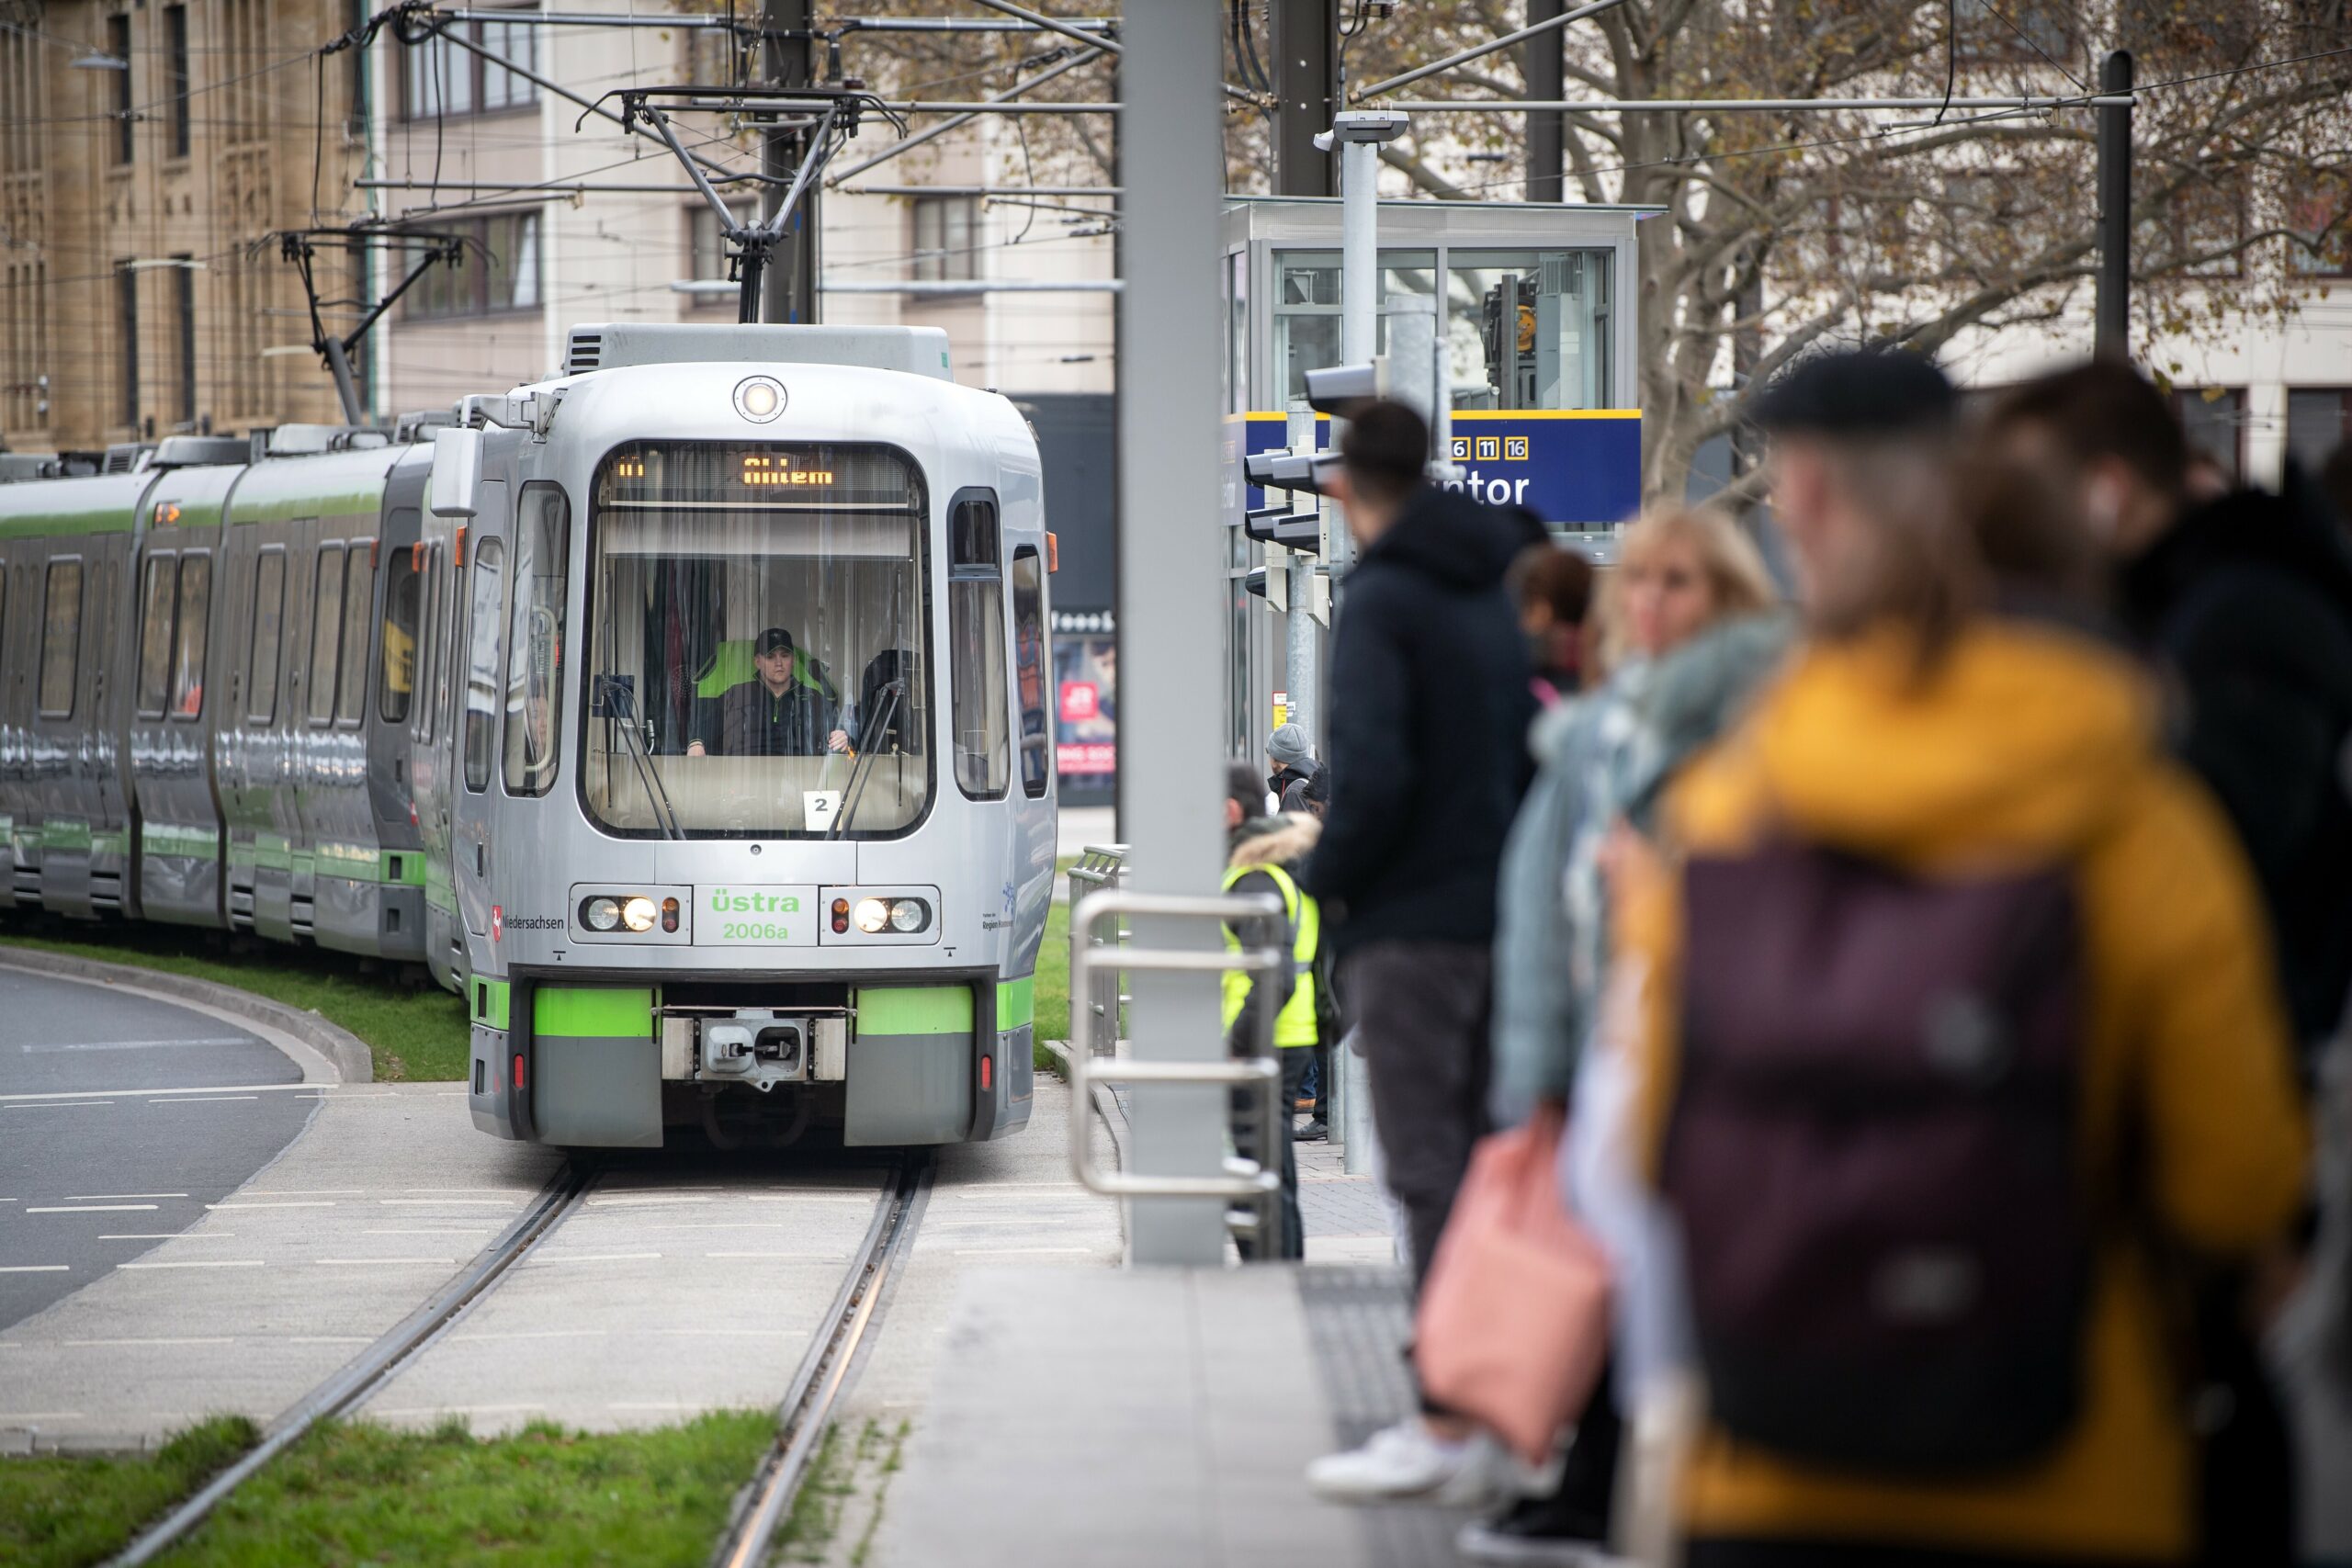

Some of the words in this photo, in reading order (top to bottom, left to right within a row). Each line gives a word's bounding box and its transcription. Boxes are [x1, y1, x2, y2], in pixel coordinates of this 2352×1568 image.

[1453, 441, 1465, 457] 6
[1479, 441, 1496, 457] 11
[1508, 441, 1525, 457] 16
[814, 797, 829, 812] 2
[712, 888, 799, 912] üstra
[503, 914, 564, 930] Niedersachsen
[723, 922, 788, 940] 2006a
